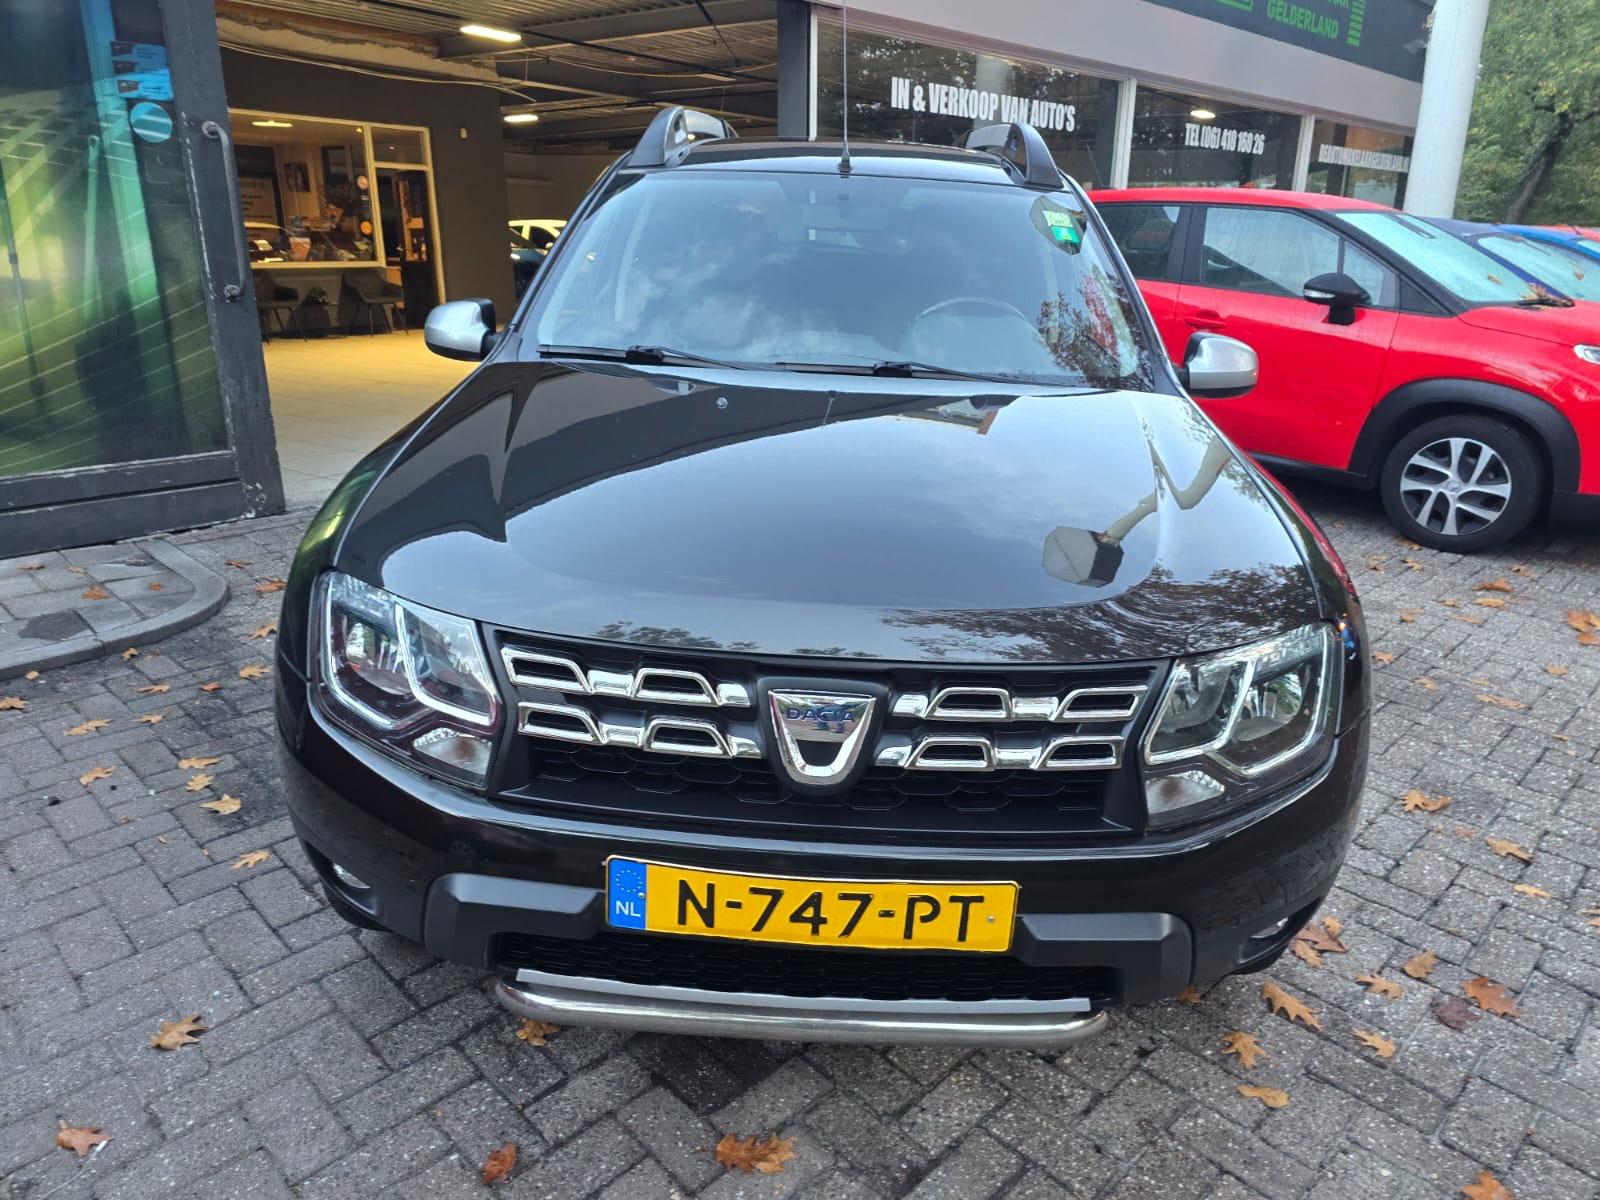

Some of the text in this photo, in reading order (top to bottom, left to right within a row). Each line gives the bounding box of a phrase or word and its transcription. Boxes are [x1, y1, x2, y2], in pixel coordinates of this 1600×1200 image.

[1267, 0, 1339, 39] GELDERLAND
[891, 76, 1076, 132] IN & VERKOOP VAN AUTO'S
[1184, 122, 1200, 148] TEL
[1252, 133, 1266, 156] 26
[786, 706, 855, 722] DACIA
[615, 899, 641, 918] NL
[677, 878, 985, 943] N-747-PT
